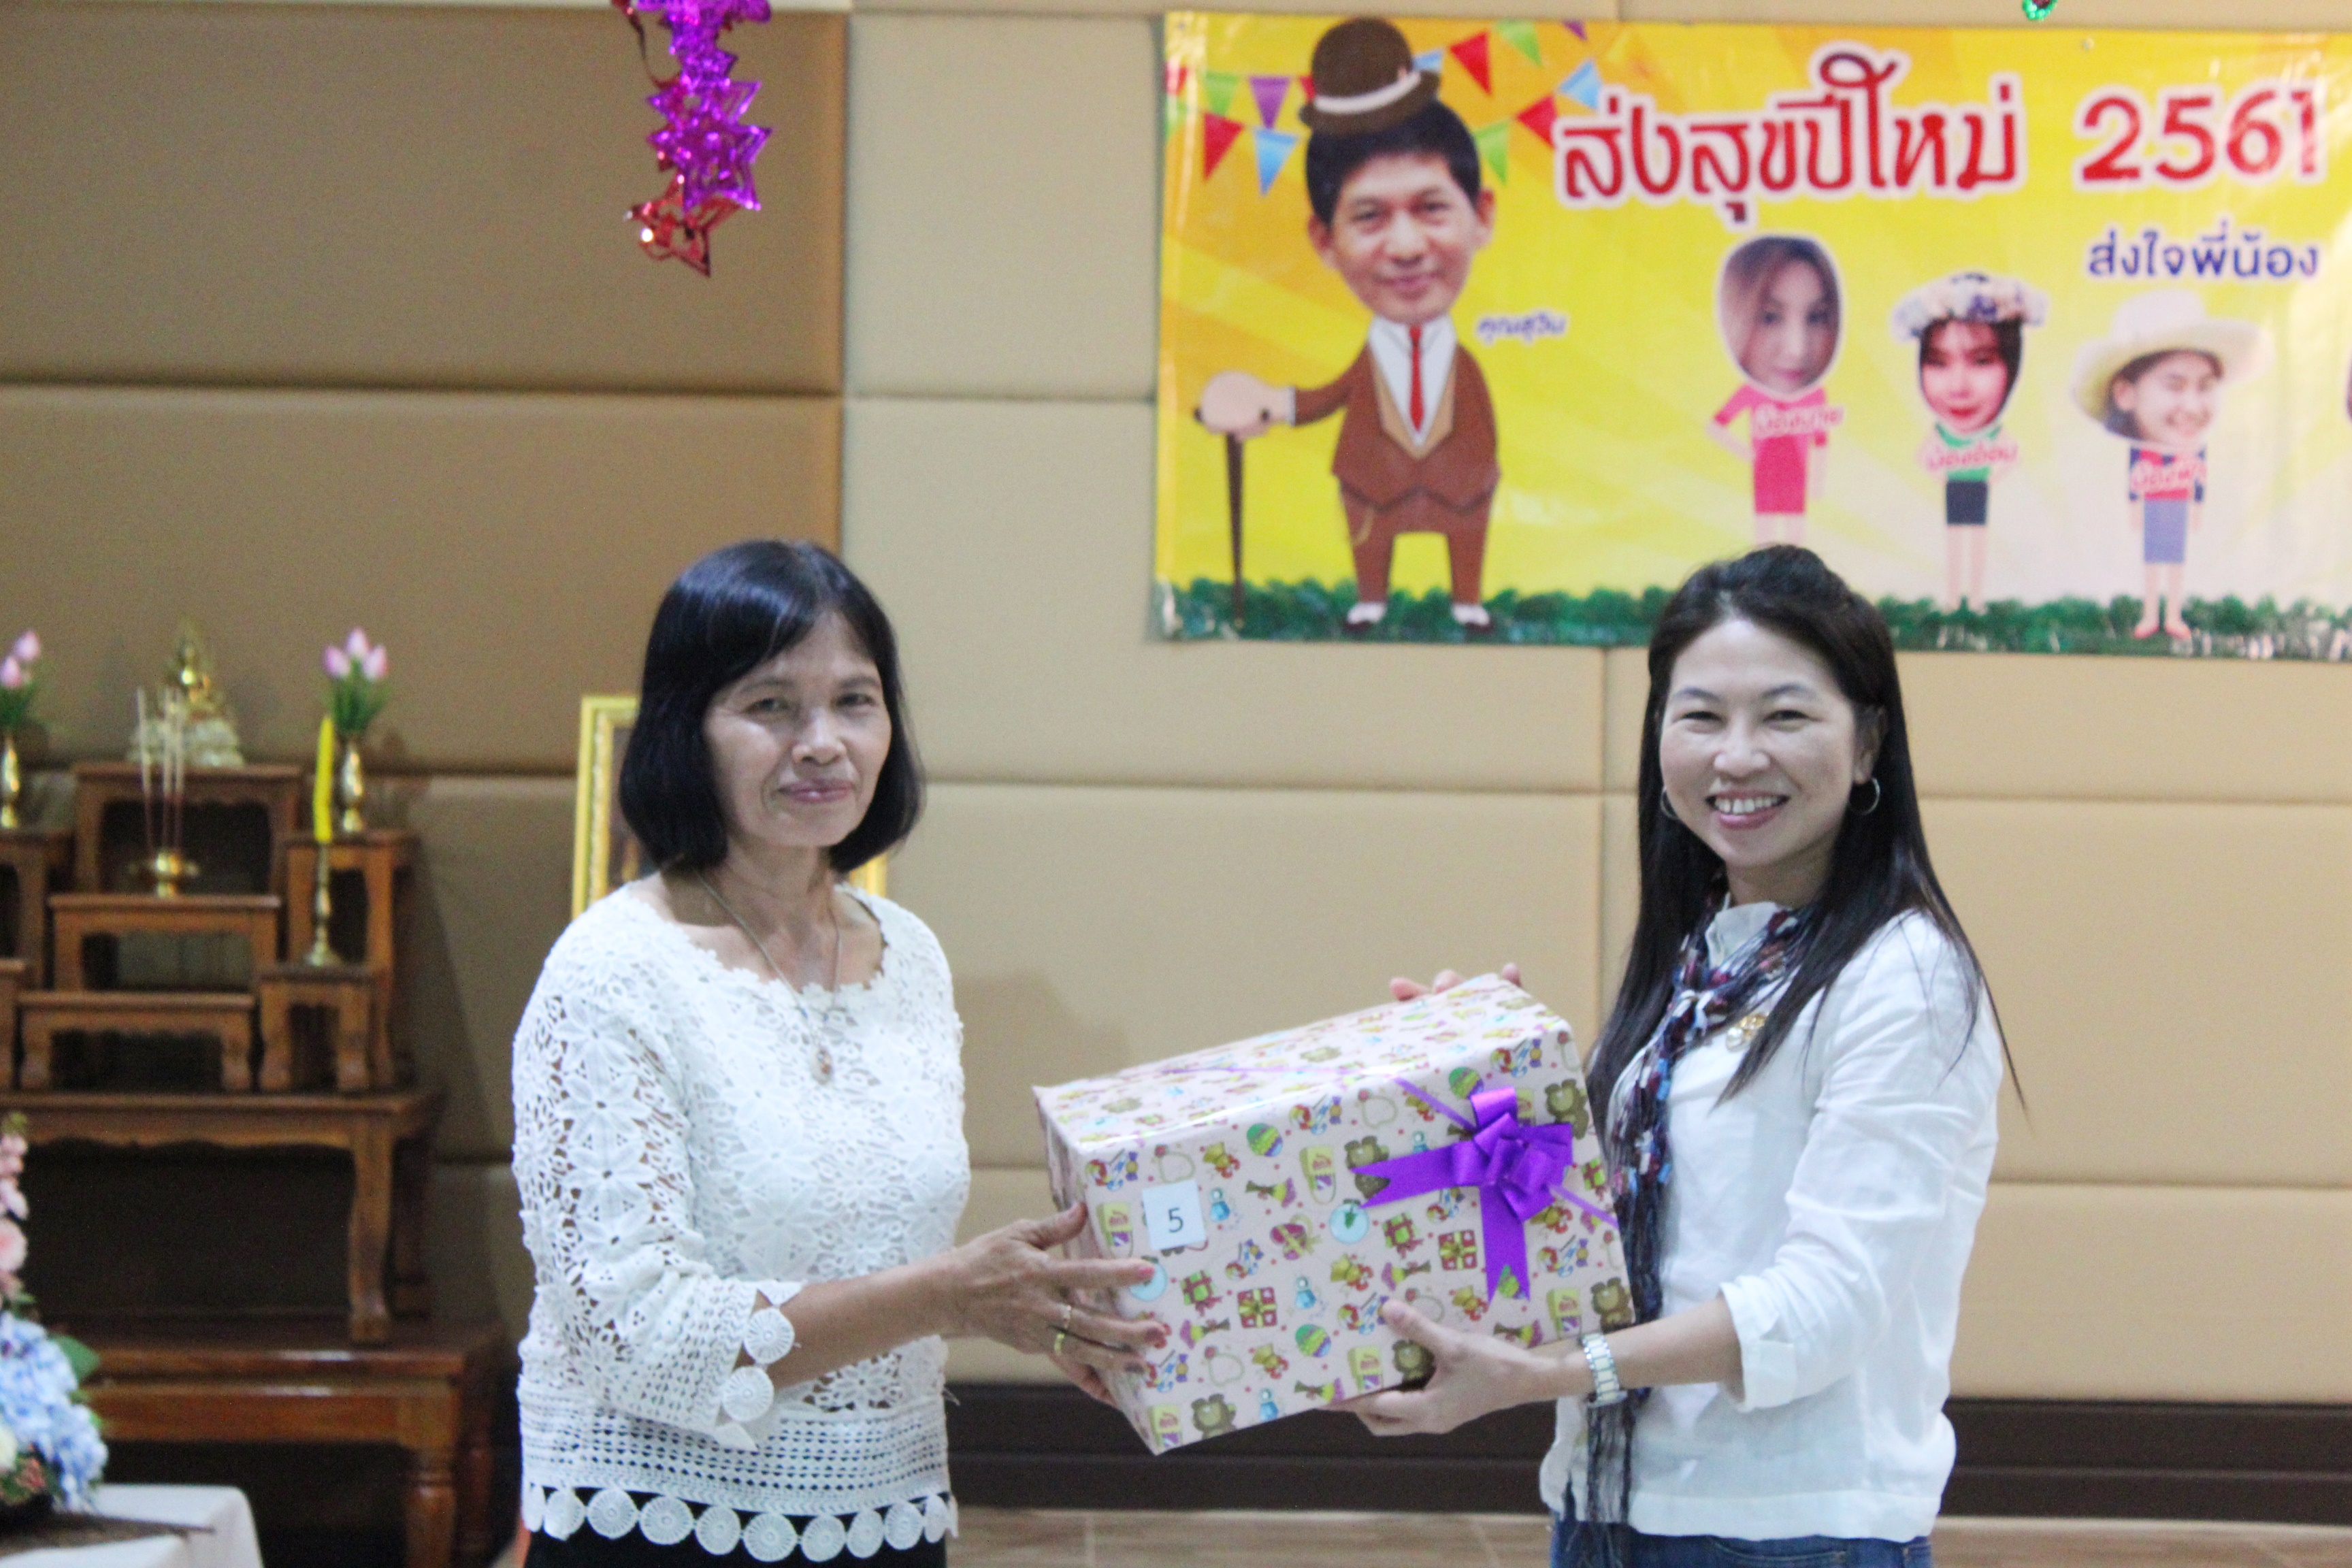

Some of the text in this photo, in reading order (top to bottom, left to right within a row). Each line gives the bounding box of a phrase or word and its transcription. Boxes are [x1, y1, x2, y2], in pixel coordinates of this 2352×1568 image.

[1563, 52, 2316, 221] ส่งสุขปีใหม่ 2561
[2088, 219, 2318, 278] ส่งใจพี่น้อง
[1168, 1207, 1183, 1232] 5
